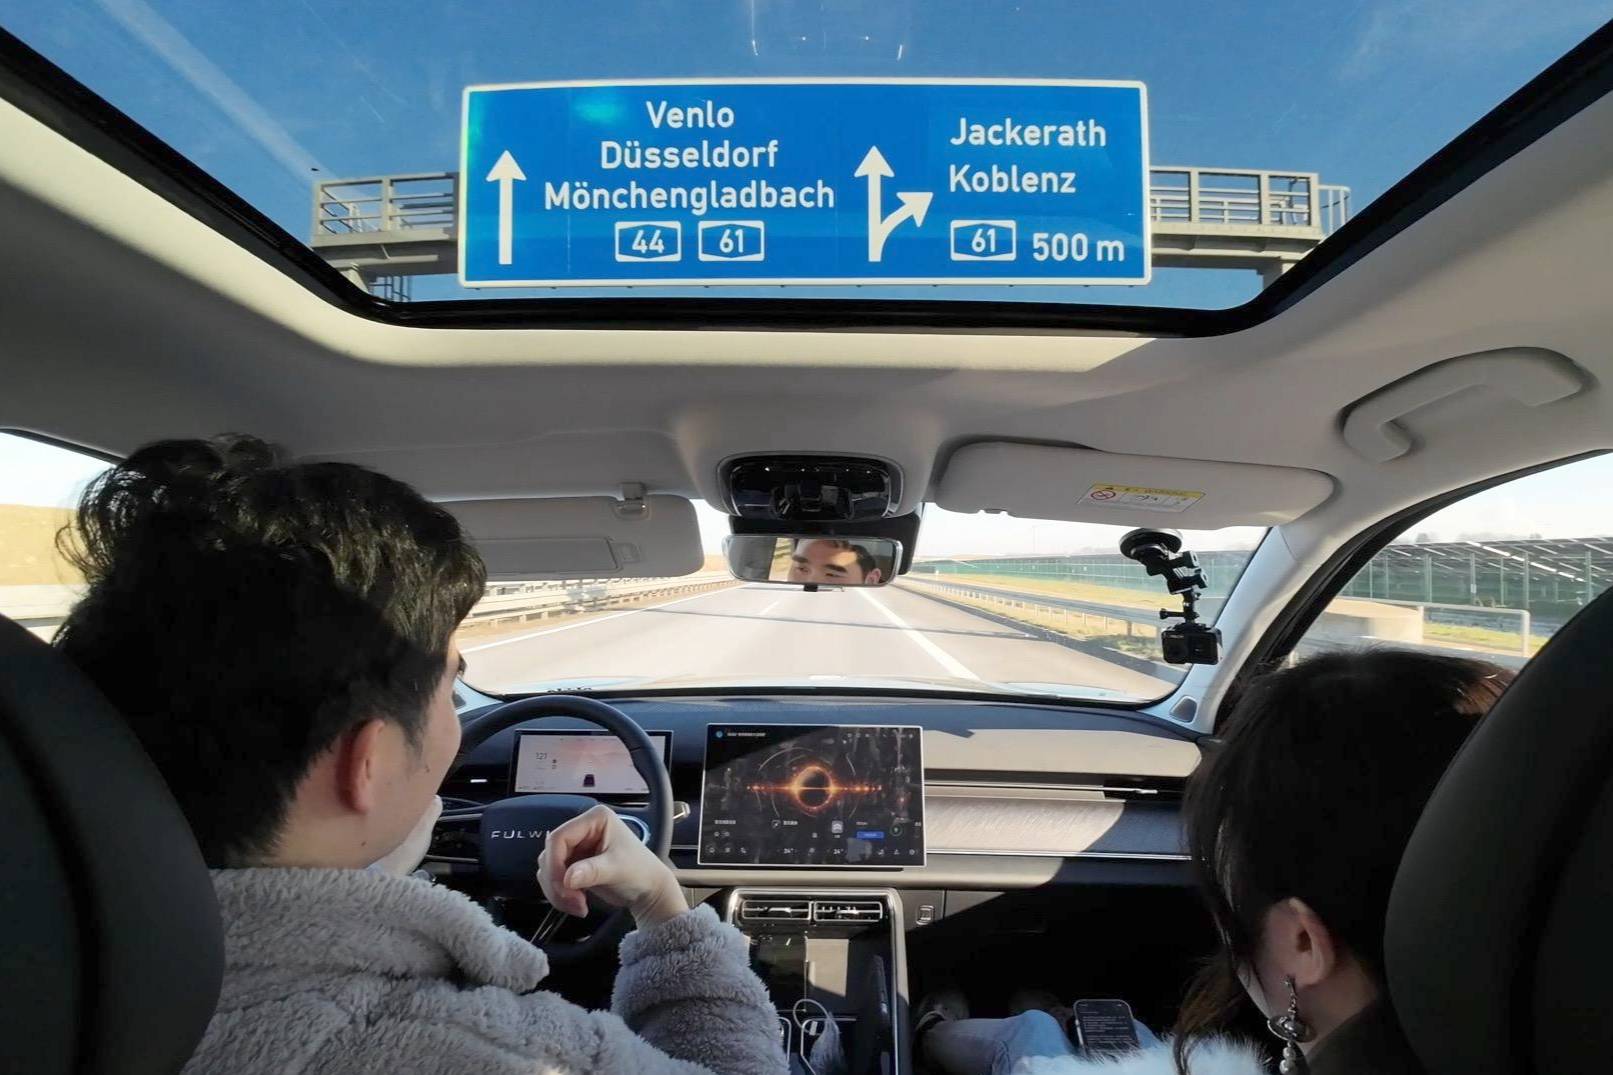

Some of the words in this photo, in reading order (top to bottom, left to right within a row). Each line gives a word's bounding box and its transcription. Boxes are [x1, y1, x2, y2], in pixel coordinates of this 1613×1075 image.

[646, 100, 735, 129] Venlo
[950, 117, 1107, 147] Jackerath
[601, 139, 778, 169] Düsseldorf
[950, 164, 1076, 194] Koblenz
[545, 180, 835, 216] Mönchengladbach
[631, 230, 665, 254] 44
[718, 230, 745, 254] 61
[971, 229, 997, 254] 61
[1033, 233, 1088, 261] 500
[1097, 240, 1125, 261] m
